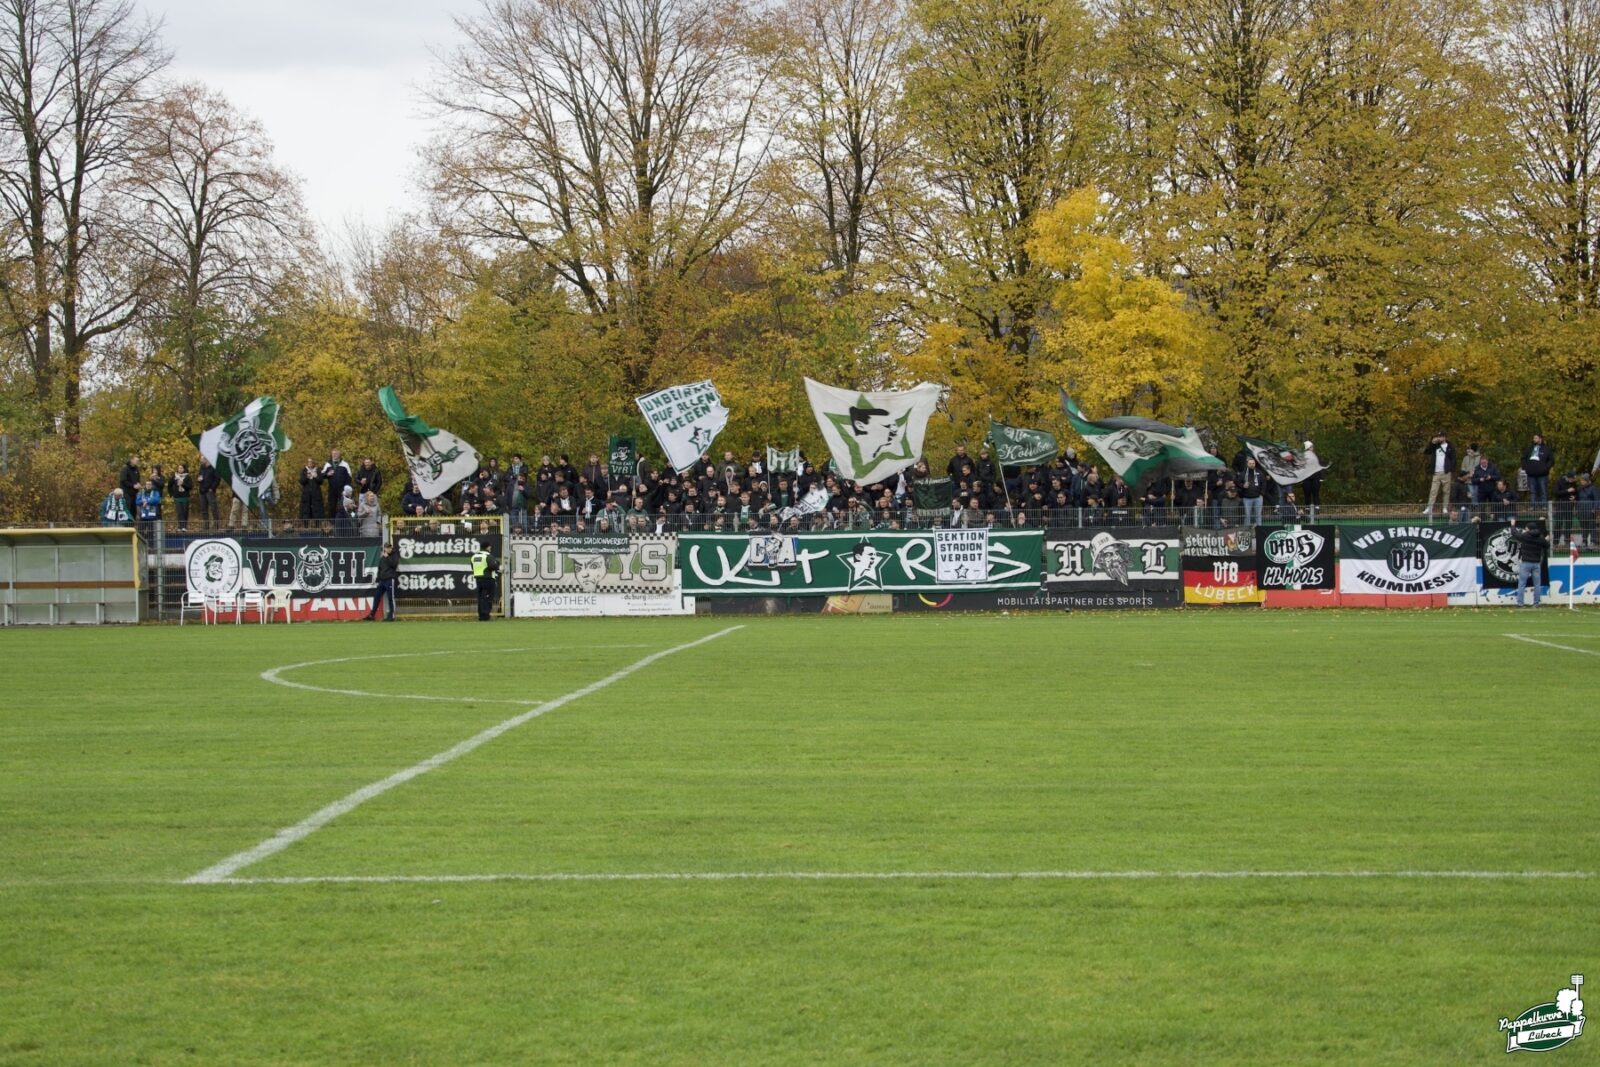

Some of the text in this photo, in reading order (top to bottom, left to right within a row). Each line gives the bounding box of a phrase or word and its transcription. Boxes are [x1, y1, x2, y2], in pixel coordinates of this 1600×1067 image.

[676, 392, 716, 414] ALLEN
[666, 402, 711, 433] WEGEN
[559, 536, 629, 546] SEKTION STADIONVERBOT
[937, 532, 985, 542] SEKTION
[1387, 526, 1465, 549] FANCLUB
[398, 538, 480, 559] Frontsid
[940, 542, 982, 552] STADION
[1269, 538, 1295, 556] VfB
[940, 553, 983, 563] VERBOT
[1391, 549, 1426, 572] VfB
[247, 551, 296, 585] VB
[330, 551, 375, 585] HL
[1213, 561, 1239, 585] VfB
[1263, 567, 1324, 585] HL HOOLS
[397, 574, 456, 590] Lübeck
[1356, 570, 1460, 592] KRUMMESSE
[1195, 582, 1256, 600] LÜBECK
[540, 596, 597, 605] APOTHEKE
[997, 595, 1153, 606] MOBILITÄTSPARTNER DES SPORTS
